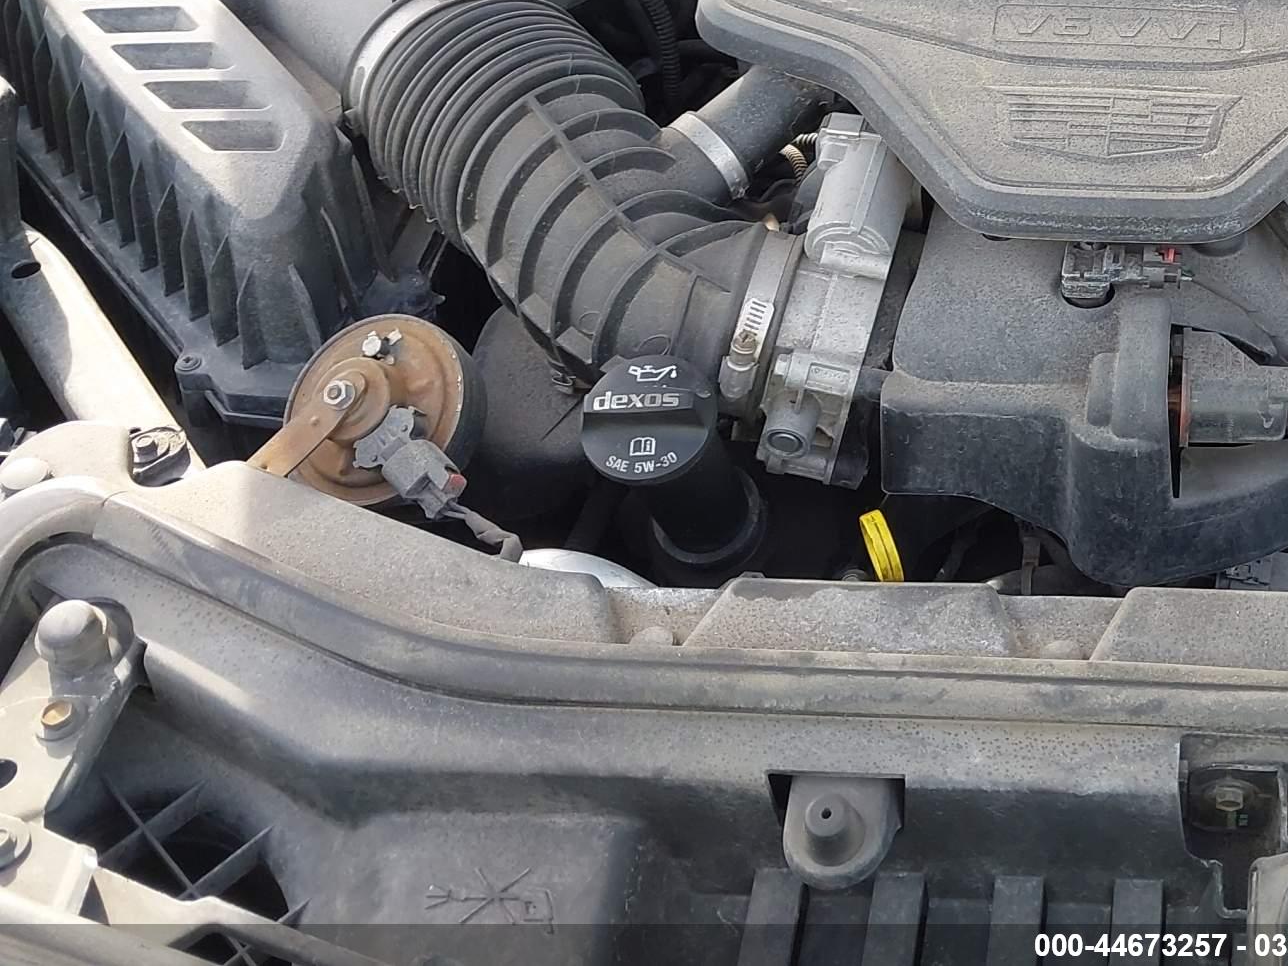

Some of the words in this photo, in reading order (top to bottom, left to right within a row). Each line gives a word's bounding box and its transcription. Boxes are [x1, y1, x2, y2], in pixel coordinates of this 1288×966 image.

[1009, 11, 1093, 36] V6
[1110, 15, 1236, 45] VVT
[593, 391, 680, 411] dexos
[605, 455, 630, 472] SAE
[633, 451, 678, 474] 5W-30
